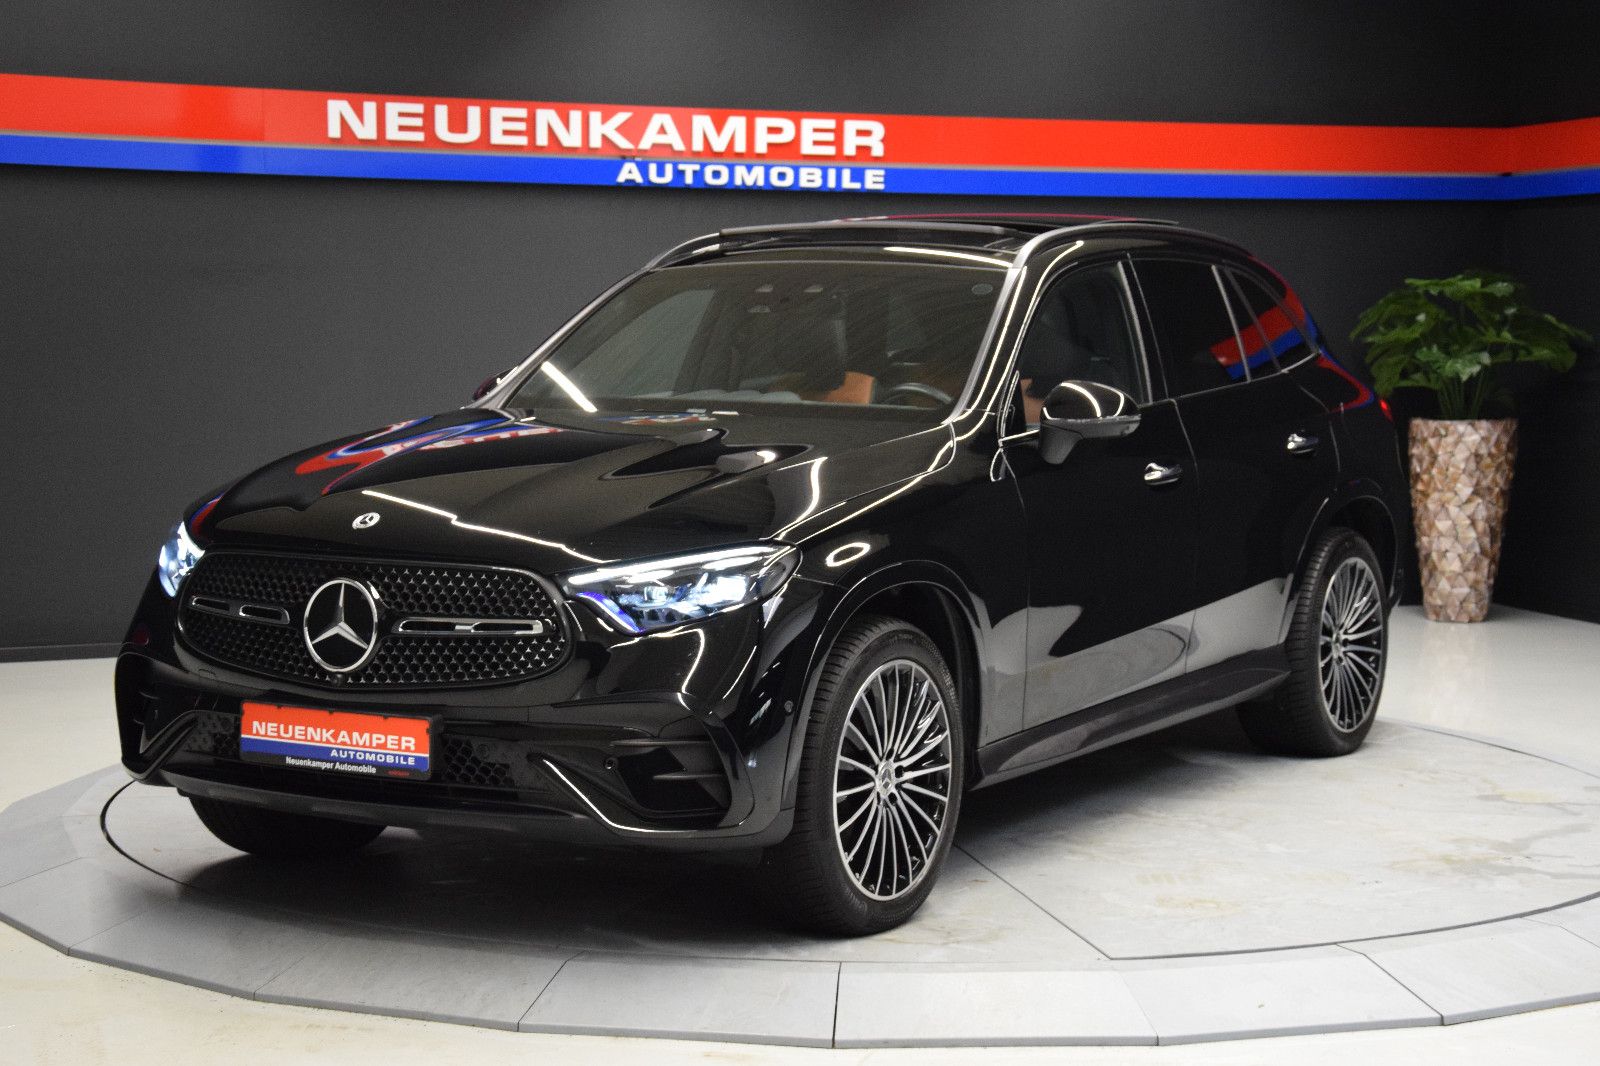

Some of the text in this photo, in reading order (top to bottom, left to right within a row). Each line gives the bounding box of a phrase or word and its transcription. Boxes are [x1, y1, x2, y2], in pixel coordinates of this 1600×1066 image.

[326, 98, 886, 157] NEUENKAMPER
[616, 162, 886, 190] AUTOMOBILE
[252, 720, 416, 751] NEUENKAMPER
[285, 756, 334, 770] Neuenkamper
[334, 762, 377, 774] Automobile
[330, 749, 416, 765] AUTOMOBILE
